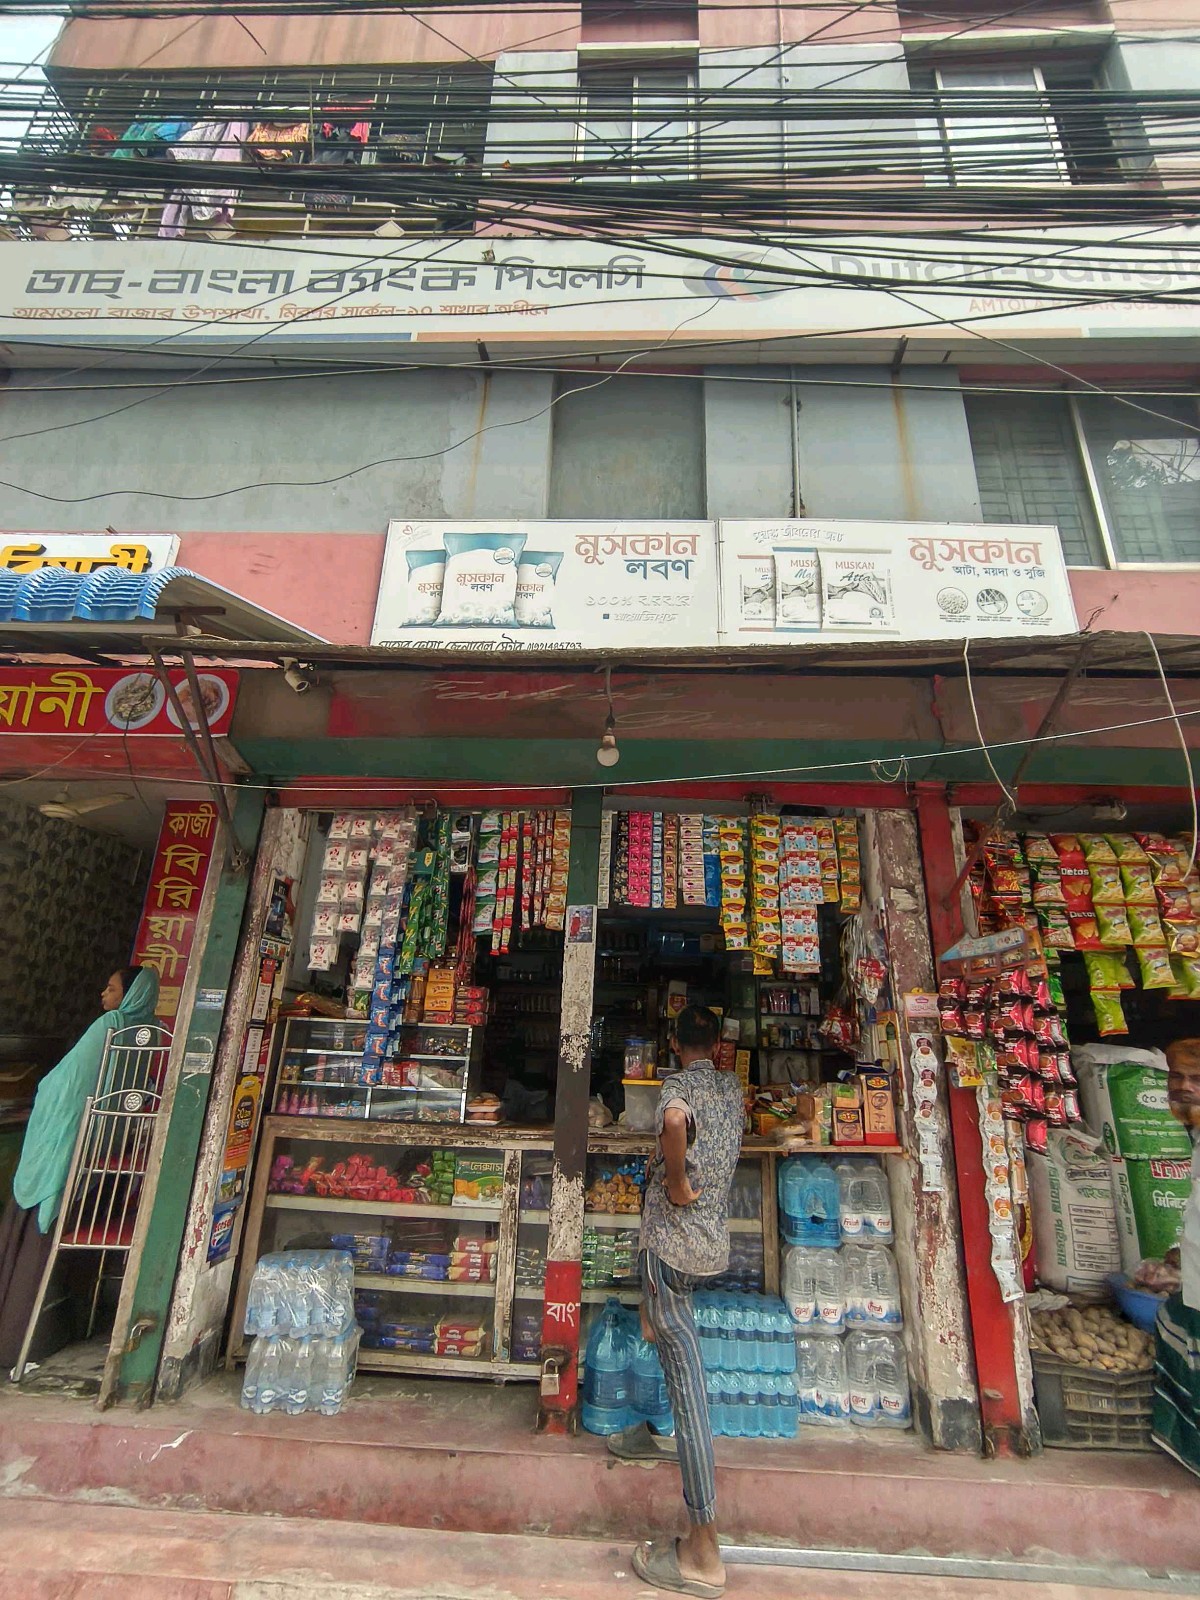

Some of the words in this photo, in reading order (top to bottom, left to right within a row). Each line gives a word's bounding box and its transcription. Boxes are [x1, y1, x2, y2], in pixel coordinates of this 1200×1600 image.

[306, 266, 478, 294] ব্যাংক
[493, 254, 646, 292] পিএলসি
[107, 307, 177, 320] বাজার
[574, 533, 701, 565] মুসকান
[908, 536, 1043, 573] মুসকান
[625, 559, 695, 580] লবণ
[835, 561, 875, 570] MUSKAN
[456, 572, 506, 587] মুসকান
[471, 583, 495, 593] লবণ
[168, 803, 217, 839] কাজী
